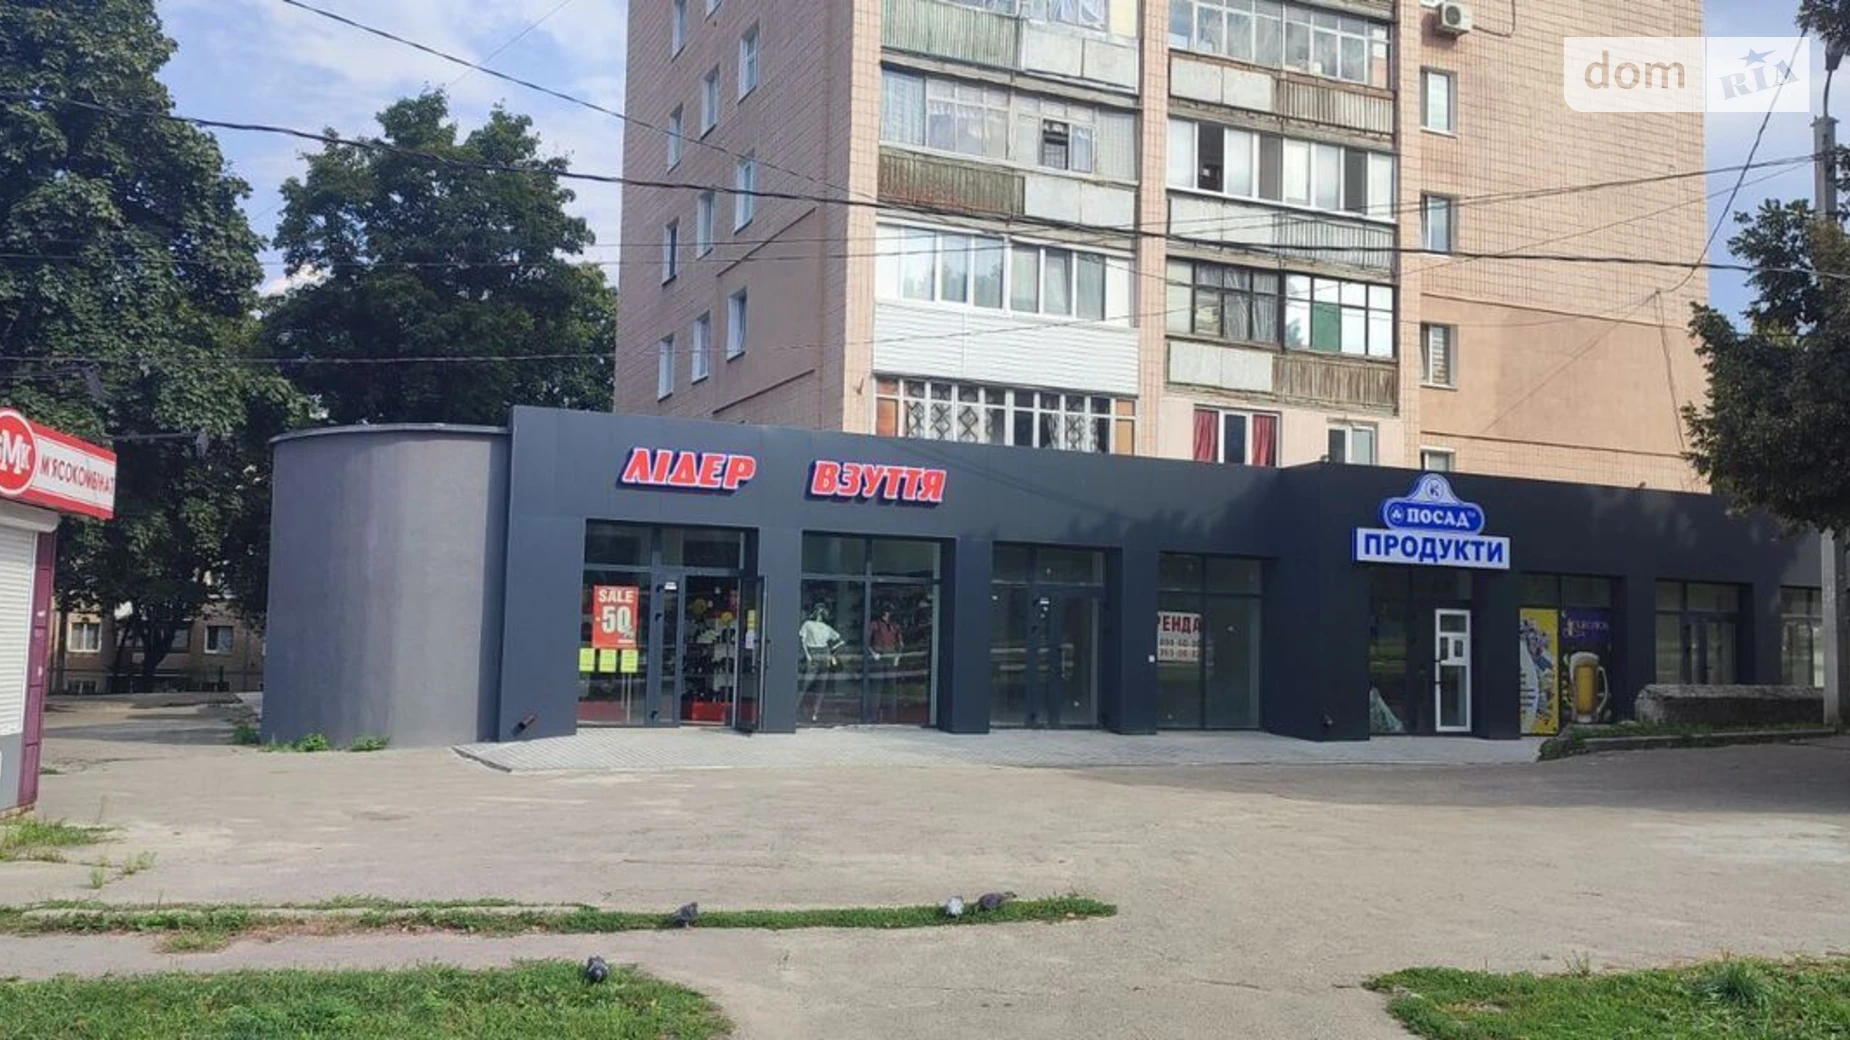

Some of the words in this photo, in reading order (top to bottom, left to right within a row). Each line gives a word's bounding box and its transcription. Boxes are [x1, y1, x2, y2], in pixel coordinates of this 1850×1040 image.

[620, 446, 757, 490] ЛІДЕР
[810, 459, 948, 503] ВЗУТТЯ
[1406, 507, 1471, 529] ПОСАД
[1363, 532, 1504, 564] ПРОДУКТИ
[598, 590, 634, 604] SALE
